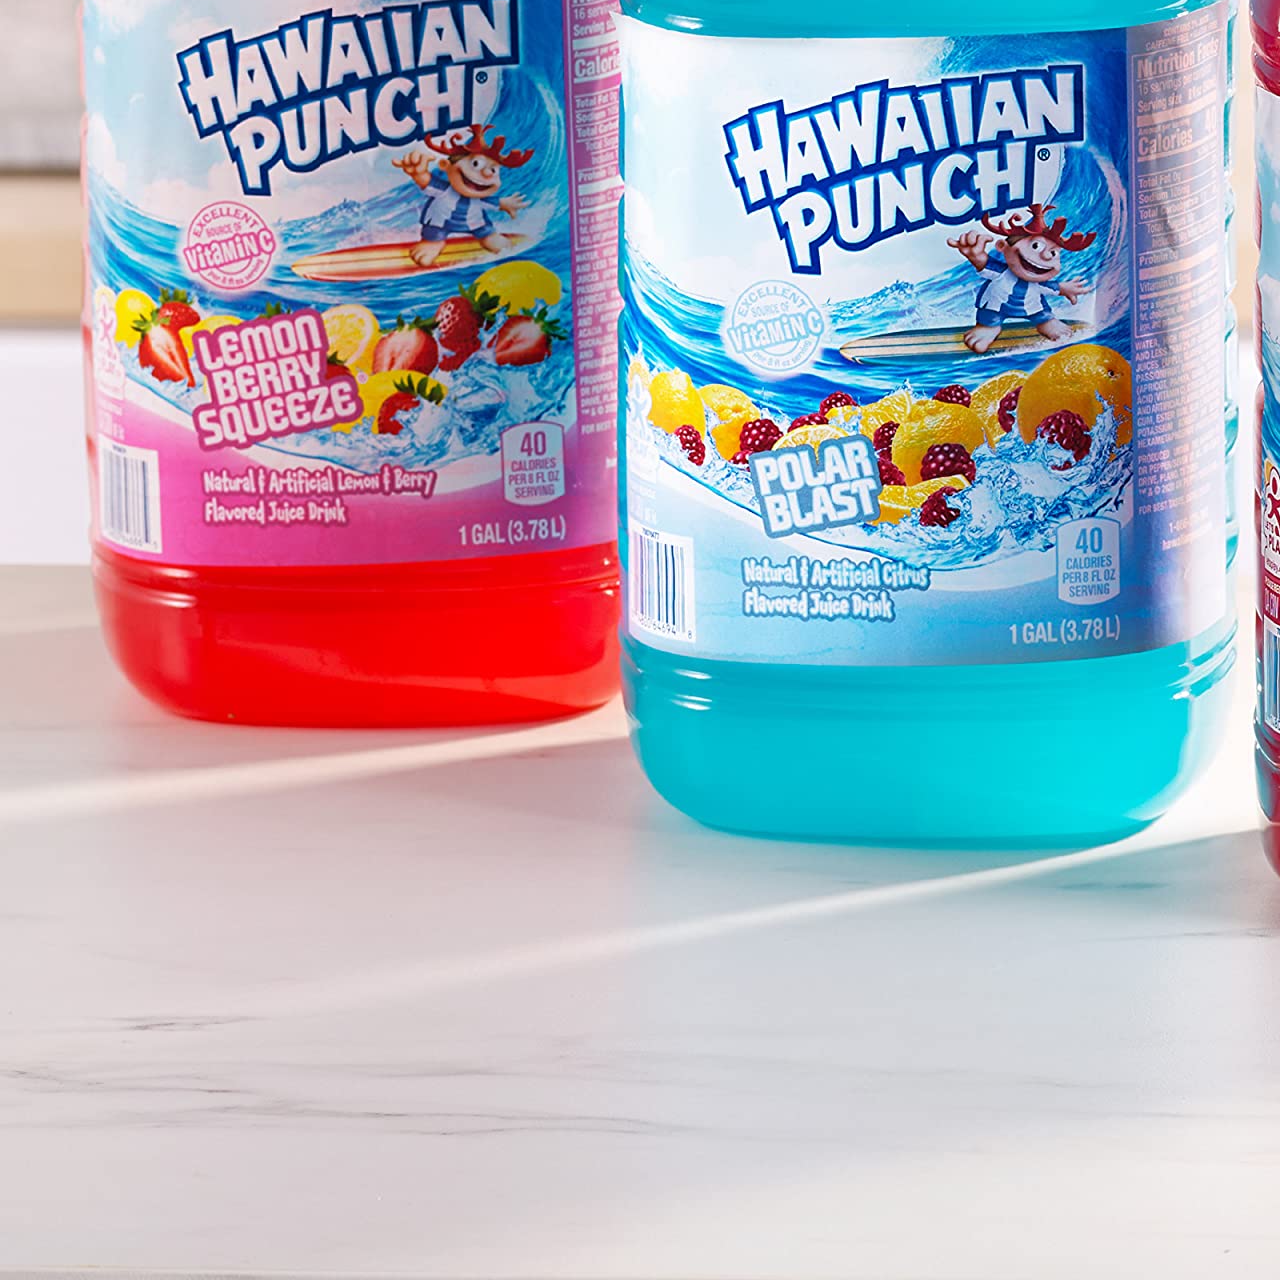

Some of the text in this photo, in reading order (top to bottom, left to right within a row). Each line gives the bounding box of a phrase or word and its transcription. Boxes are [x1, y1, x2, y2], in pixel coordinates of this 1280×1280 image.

[575, 53, 620, 77] Calori
[1137, 49, 1195, 79] Nutrition
[724, 64, 1083, 214] HAWAIIAN
[1137, 127, 1194, 156] Calories
[193, 207, 258, 237] EXCELLENT
[257, 228, 276, 254] C
[738, 286, 807, 317] EXCELLENT
[805, 308, 824, 336] C
[198, 315, 322, 370] LEMON
[213, 351, 321, 405] BERRY
[198, 382, 356, 446] SQUEEZE
[520, 431, 547, 457] 40
[508, 473, 527, 486] PER
[535, 471, 546, 483] FL
[547, 470, 560, 482] OZ
[511, 457, 557, 472] CALORIES
[754, 440, 874, 496] POLAR
[203, 469, 256, 493] Natural
[268, 468, 335, 493] Artificial
[393, 469, 434, 495] Berry
[514, 484, 555, 498] SERVING
[205, 496, 265, 524] Flavored
[269, 500, 304, 523] Juice
[764, 478, 877, 533] BLAST
[459, 526, 467, 546] 1
[472, 522, 506, 545] GAL
[1075, 527, 1103, 554] 40
[743, 557, 798, 584] Natural
[810, 558, 881, 588] Artificial
[882, 562, 928, 589] Citrus
[1063, 571, 1083, 584] PER
[1091, 570, 1102, 582] FL
[1103, 568, 1116, 581] OZ
[1066, 555, 1112, 570] CALORIES
[744, 588, 808, 618] Flavored
[810, 592, 849, 618] Juice
[1069, 583, 1110, 597] SERVING
[1009, 623, 1018, 645] 1
[1022, 621, 1058, 645] GAL
